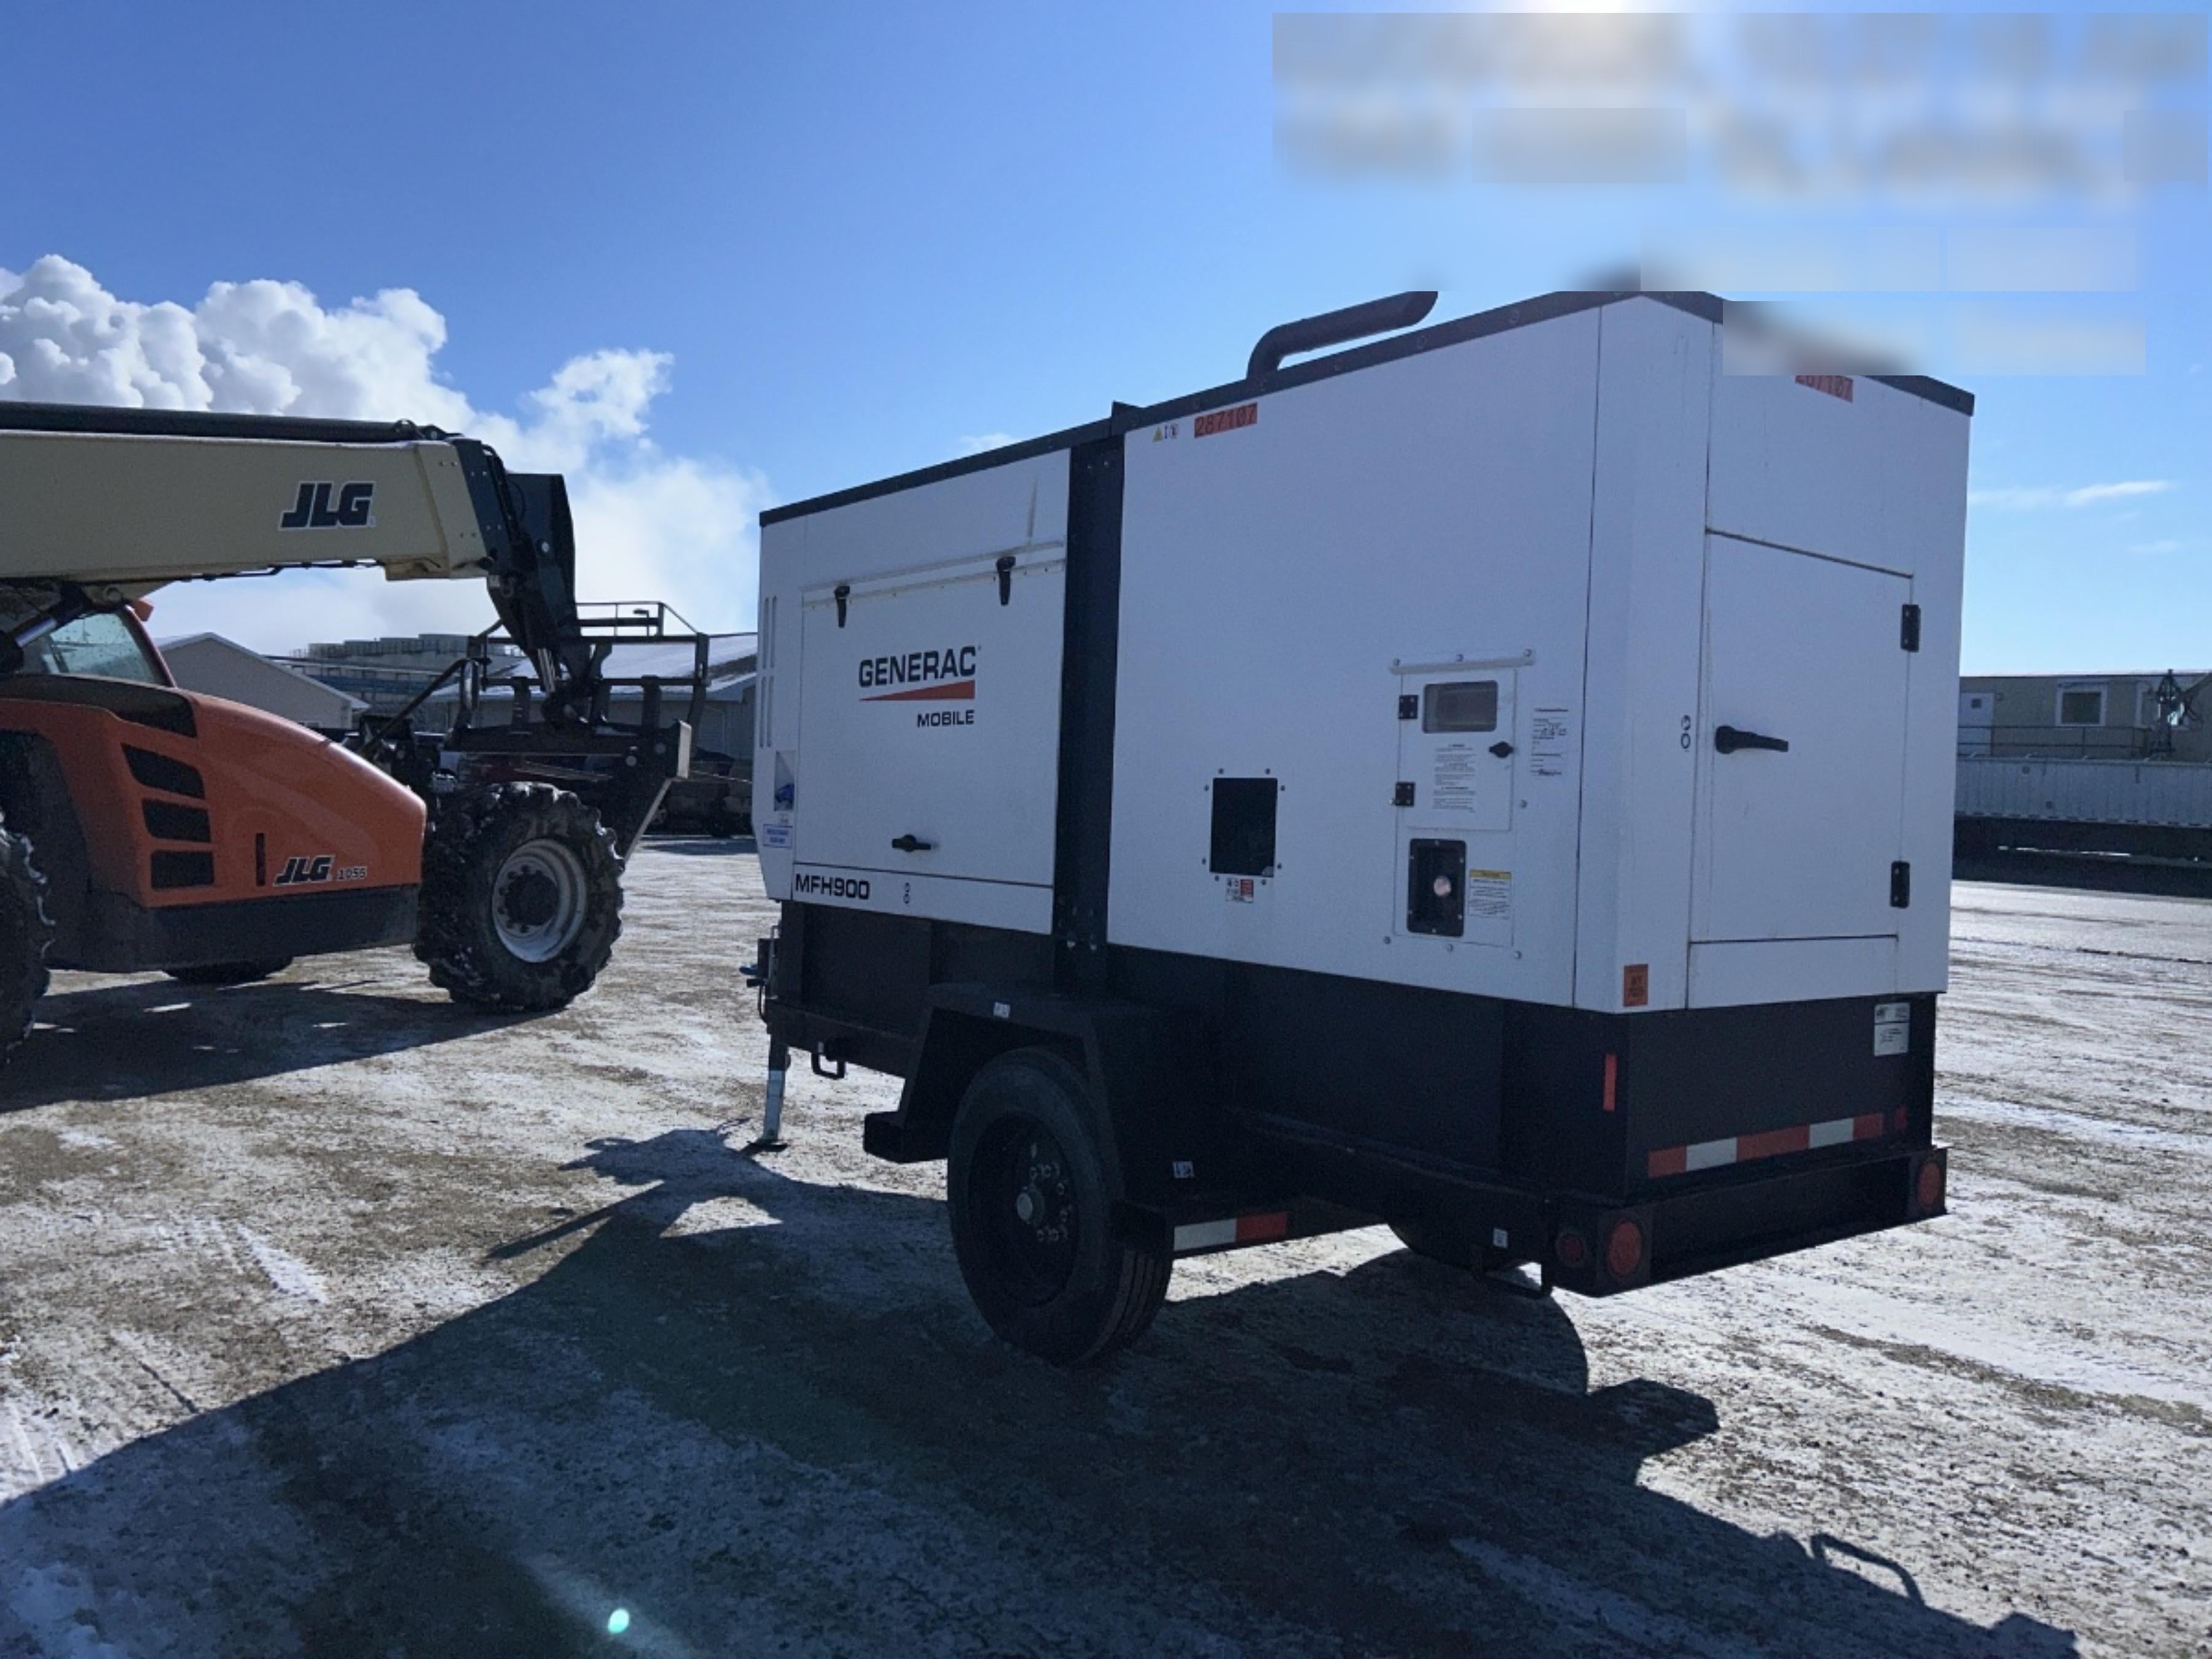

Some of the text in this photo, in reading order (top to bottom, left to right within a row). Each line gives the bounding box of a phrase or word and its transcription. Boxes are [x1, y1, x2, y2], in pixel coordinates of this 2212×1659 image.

[1194, 404, 1257, 437] 287107
[280, 482, 375, 530] JLG
[858, 646, 976, 688] GENERAC
[917, 709, 975, 728] MOBILE
[273, 855, 367, 885] JLG 1055
[795, 873, 871, 900] MFH900
